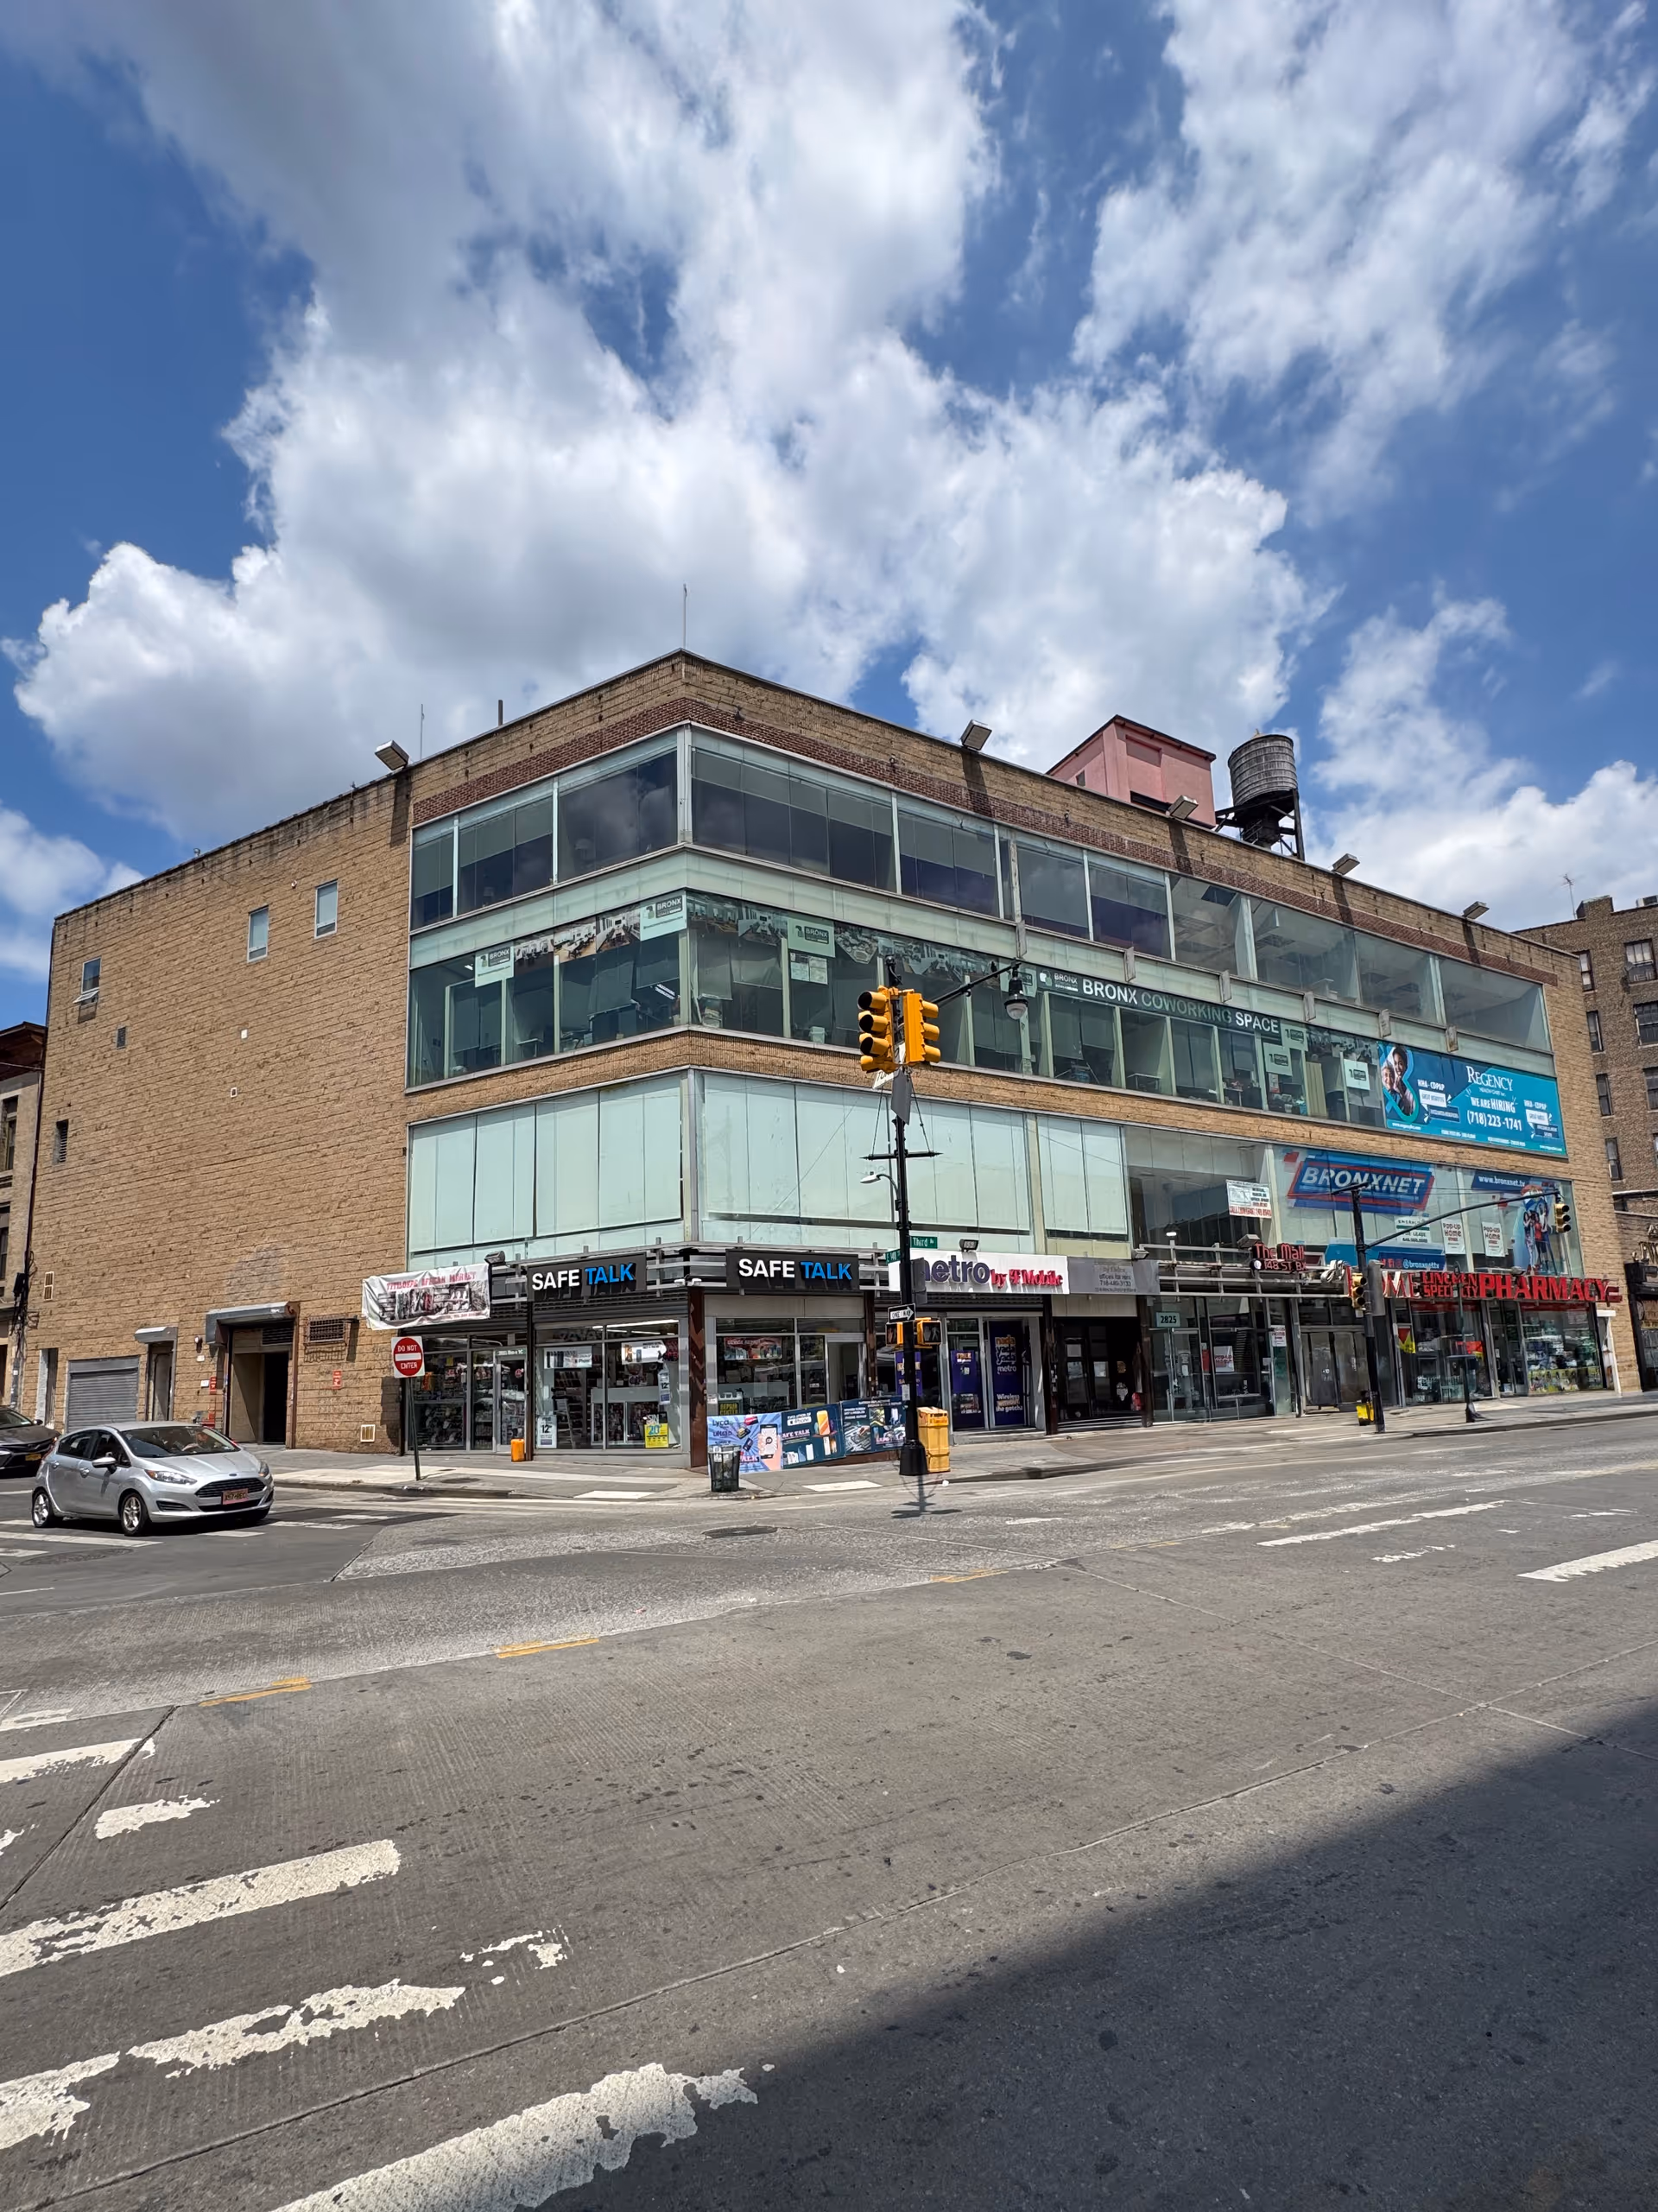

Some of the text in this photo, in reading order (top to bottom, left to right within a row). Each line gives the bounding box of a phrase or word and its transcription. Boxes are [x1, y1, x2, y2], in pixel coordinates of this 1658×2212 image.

[657, 897, 681, 911] BRONX
[806, 928, 828, 939] BRONX
[1054, 973, 1078, 985] BRONX
[1082, 978, 1138, 1005] BRONX
[1141, 992, 1232, 1024] COWORKING
[1235, 1011, 1280, 1034] SPACE
[1465, 1065, 1513, 1092] REGENCY
[1471, 1096, 1480, 1107] WE
[1490, 1098, 1516, 1113] HIRING
[1466, 1110, 1487, 1127] (718)
[1301, 1167, 1425, 1195] BRONXNET
[1478, 1176, 1526, 1187] www.bronxnet.tv
[913, 1237, 928, 1247] Third
[1254, 1243, 1305, 1259] The Mall
[738, 1258, 852, 1280] SAFE TALK
[924, 1254, 990, 1284] etro
[990, 1269, 1008, 1289] by
[1264, 1260, 1279, 1270] 148
[1281, 1261, 1292, 1270] ST
[532, 1263, 635, 1290] SAFE TALK
[1424, 1284, 1479, 1298] SPECILTY
[1479, 1272, 1610, 1302] PHARMACY
[1160, 1315, 1177, 1324] 2825
[400, 1361, 418, 1370] ENTER
